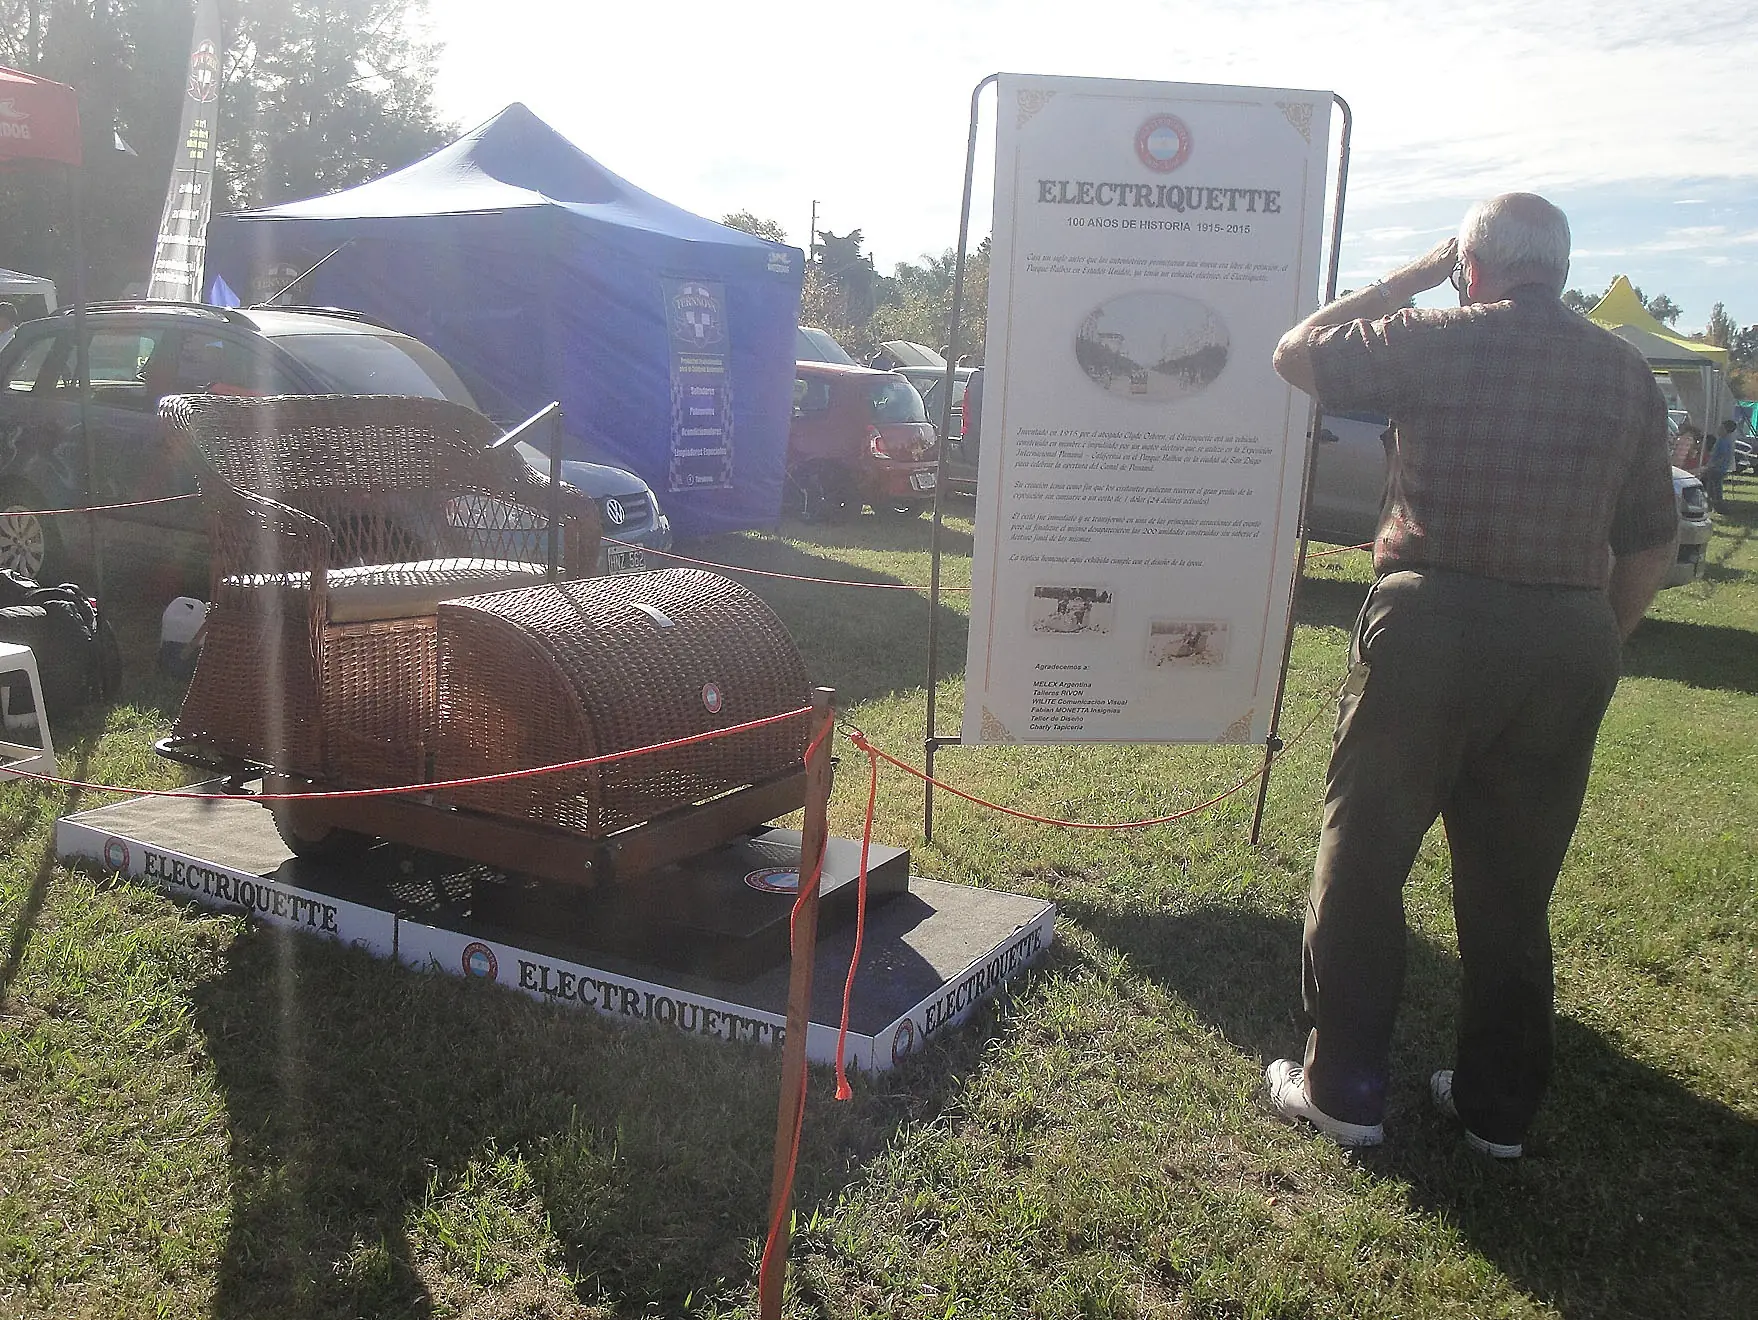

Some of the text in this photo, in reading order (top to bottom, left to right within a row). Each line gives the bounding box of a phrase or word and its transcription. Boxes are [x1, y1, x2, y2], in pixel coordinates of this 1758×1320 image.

[1038, 178, 1281, 214] ELECTRIQUETTE
[1067, 217, 1085, 227] 100
[1087, 215, 1119, 229] AÑOS
[1122, 219, 1137, 229] DE
[1139, 220, 1191, 232] HISTORIA
[1016, 426, 1048, 435] Inventado
[1058, 428, 1078, 436] 1915
[1015, 447, 1058, 457] Internacional
[1014, 461, 1030, 469] para
[1100, 461, 1118, 470] Canal
[1035, 663, 1081, 671] Agradecemos
[1059, 681, 1092, 689] Argentina
[1090, 707, 1121, 715] Insignias
[1029, 723, 1051, 732] Charly
[144, 850, 338, 933] ELECTRIQUETTE
[925, 925, 1043, 1035] ELECTRIQUETTE
